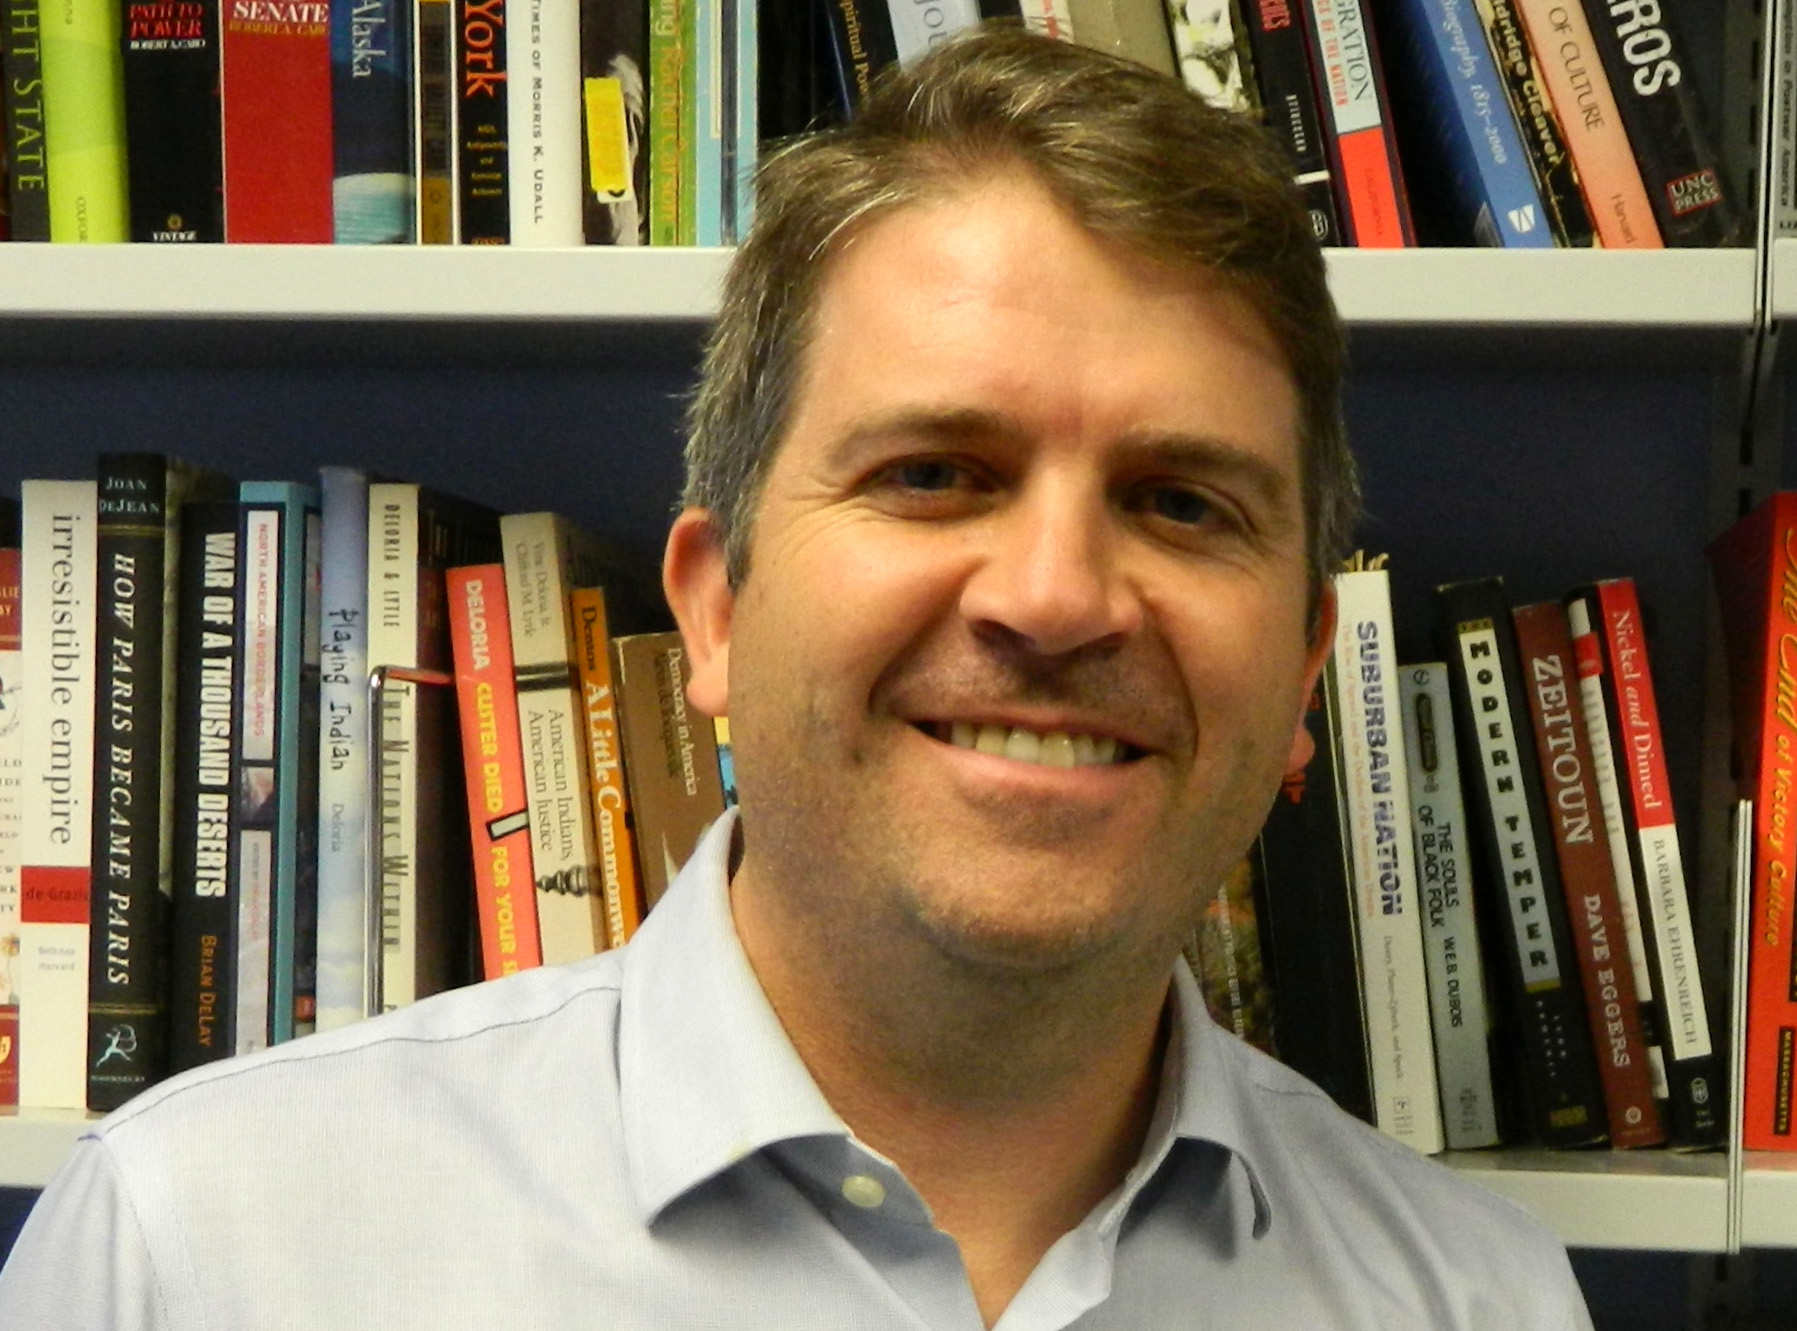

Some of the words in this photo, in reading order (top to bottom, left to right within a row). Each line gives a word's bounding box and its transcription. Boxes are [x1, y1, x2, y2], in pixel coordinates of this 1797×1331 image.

[11, 0, 40, 61] HT
[131, 19, 202, 38] POWER
[232, 0, 330, 23] SENATE
[1548, 6, 1573, 35] OF
[465, 0, 508, 98] York
[532, 50, 541, 71] OF
[1606, 0, 1682, 97] ROS
[532, 77, 542, 139] MORRIS
[658, 46, 686, 129] Rachel
[1330, 65, 1350, 107] NATION
[1559, 42, 1607, 133] CULTURE
[14, 79, 45, 191] STATE
[533, 147, 544, 162] K.
[1522, 79, 1565, 166] Cleaver
[534, 169, 544, 224] UDALL
[658, 133, 688, 224] Carson
[1670, 170, 1715, 198] UNC
[1674, 187, 1720, 212] PRESS
[152, 230, 197, 242] VINTAGE
[105, 476, 148, 490] JOAN
[204, 532, 236, 588] WAR
[258, 523, 269, 568] NORTH
[384, 504, 401, 561] DELORIA
[51, 515, 81, 705] irresistible
[113, 553, 136, 629] HOW
[202, 596, 234, 625] OF
[257, 571, 267, 638] AMERICAN
[202, 632, 233, 649] A
[323, 609, 359, 686] Playing
[465, 579, 491, 671] DELORIA
[1612, 608, 1642, 681] Nickel
[110, 639, 135, 732] PARIS
[254, 641, 266, 737] BORDERLANDS
[383, 685, 410, 723] THE
[476, 681, 499, 757] CUSTER
[586, 682, 610, 706] A
[1357, 620, 1392, 795] SUBURBAN
[1625, 685, 1650, 729] and
[198, 656, 233, 786] THOUSAND
[329, 703, 354, 770] Indian
[528, 710, 548, 793] American
[549, 709, 568, 792] American
[590, 706, 619, 783] Little
[677, 724, 690, 739] in
[1532, 654, 1594, 845] ZEITOUN
[42, 719, 78, 845] empire
[383, 739, 410, 839] NATIONS
[483, 762, 504, 814] DIED
[680, 739, 698, 797] America
[1634, 732, 1663, 811] Dimed
[109, 745, 133, 880] BECAME
[332, 803, 345, 852] Deloria
[536, 798, 556, 851] Justice
[1417, 805, 1435, 827] OF
[1437, 821, 1453, 852] THE
[1468, 640, 1515, 794] MODERN
[1504, 814, 1550, 968] TEMPER
[1767, 766, 1793, 853] Victory
[195, 793, 229, 898] DESERTS
[490, 846, 510, 888] FOR
[1373, 801, 1403, 916] NATION
[1421, 833, 1439, 883] BLACK
[383, 854, 409, 947] WITHIN
[1426, 886, 1445, 928] FOLK
[1441, 858, 1460, 909] SOULS
[1764, 859, 1788, 947] Culture
[107, 890, 131, 985] PARIS
[495, 894, 518, 954] YOUR
[1653, 839, 1680, 922] BARBARA
[1667, 925, 1698, 1046] EHRENREICH
[199, 935, 218, 986] BRIAN
[1584, 893, 1609, 962] DAVE
[1597, 968, 1631, 1068] EGGERS
[1447, 979, 1464, 1028] DUBOIS
